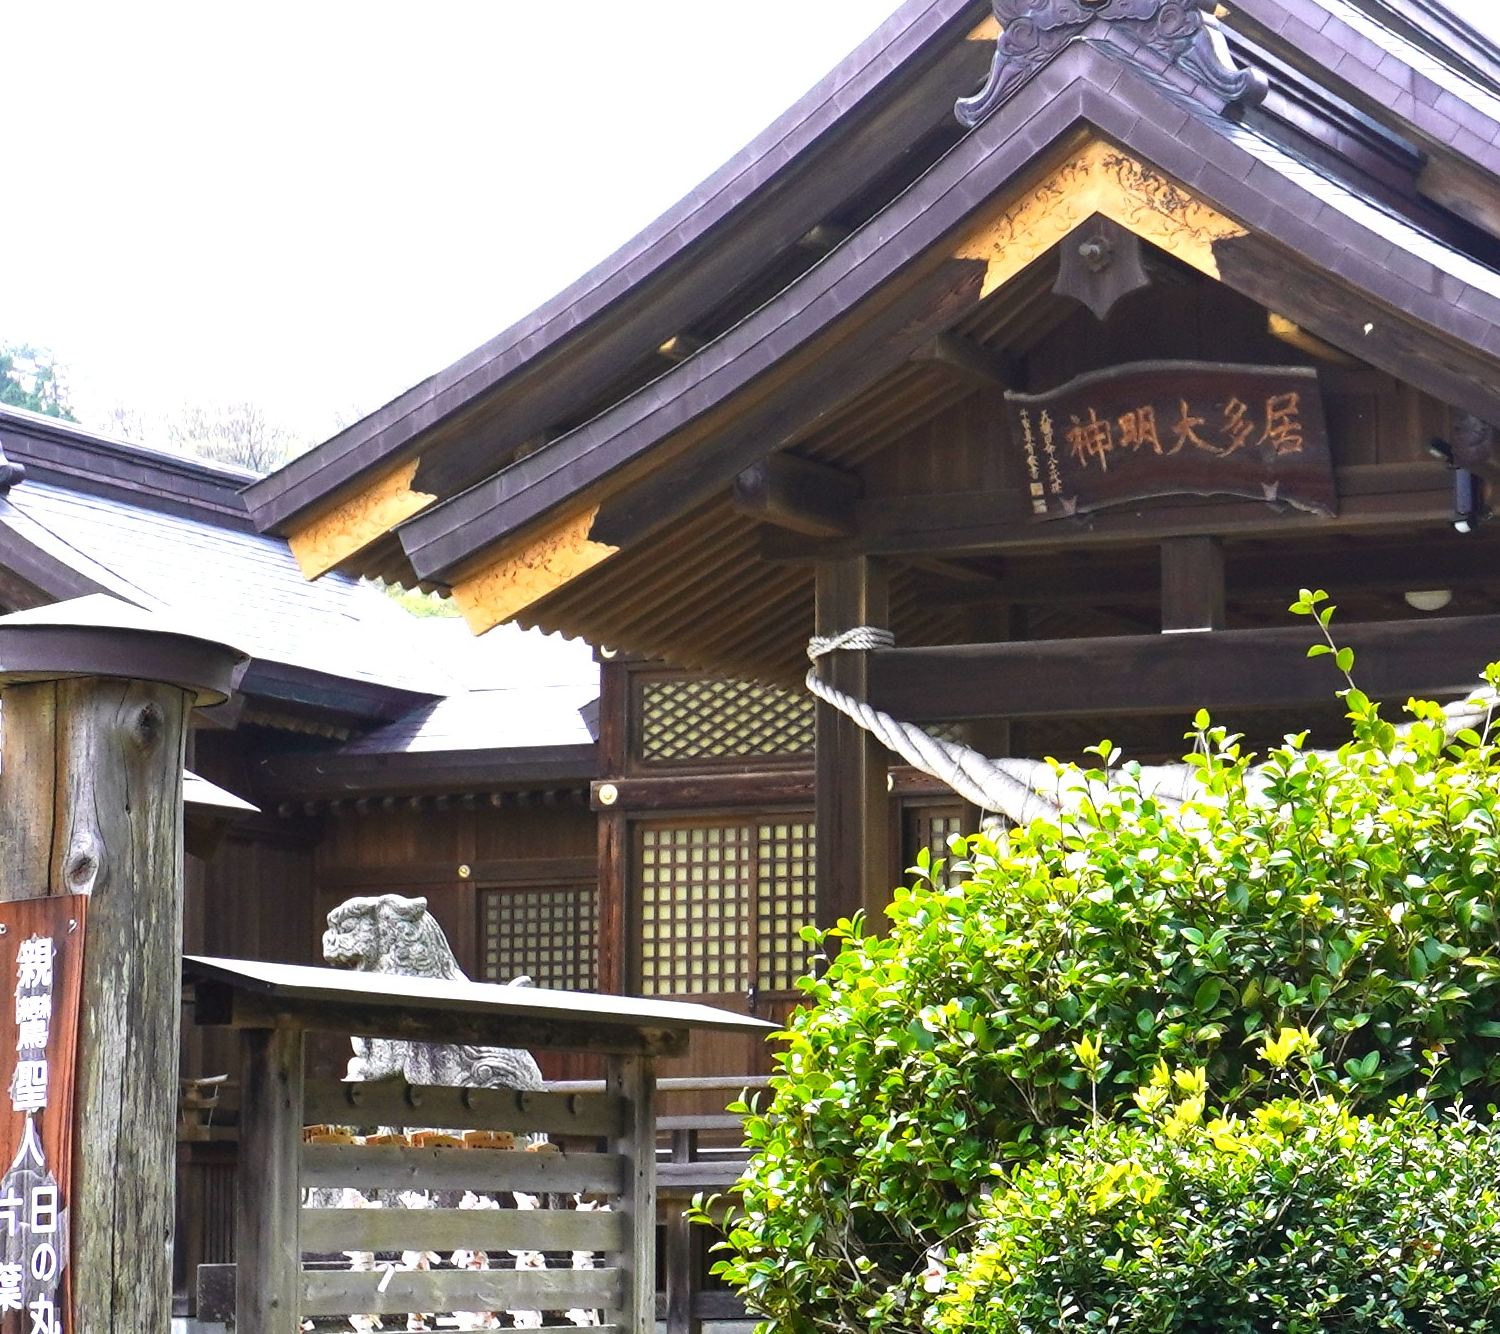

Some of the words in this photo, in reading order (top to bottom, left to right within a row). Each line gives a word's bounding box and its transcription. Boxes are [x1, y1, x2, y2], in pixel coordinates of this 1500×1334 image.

[1065, 391, 1303, 473] 居多大明神
[12, 938, 53, 1167] 親鸞聖人
